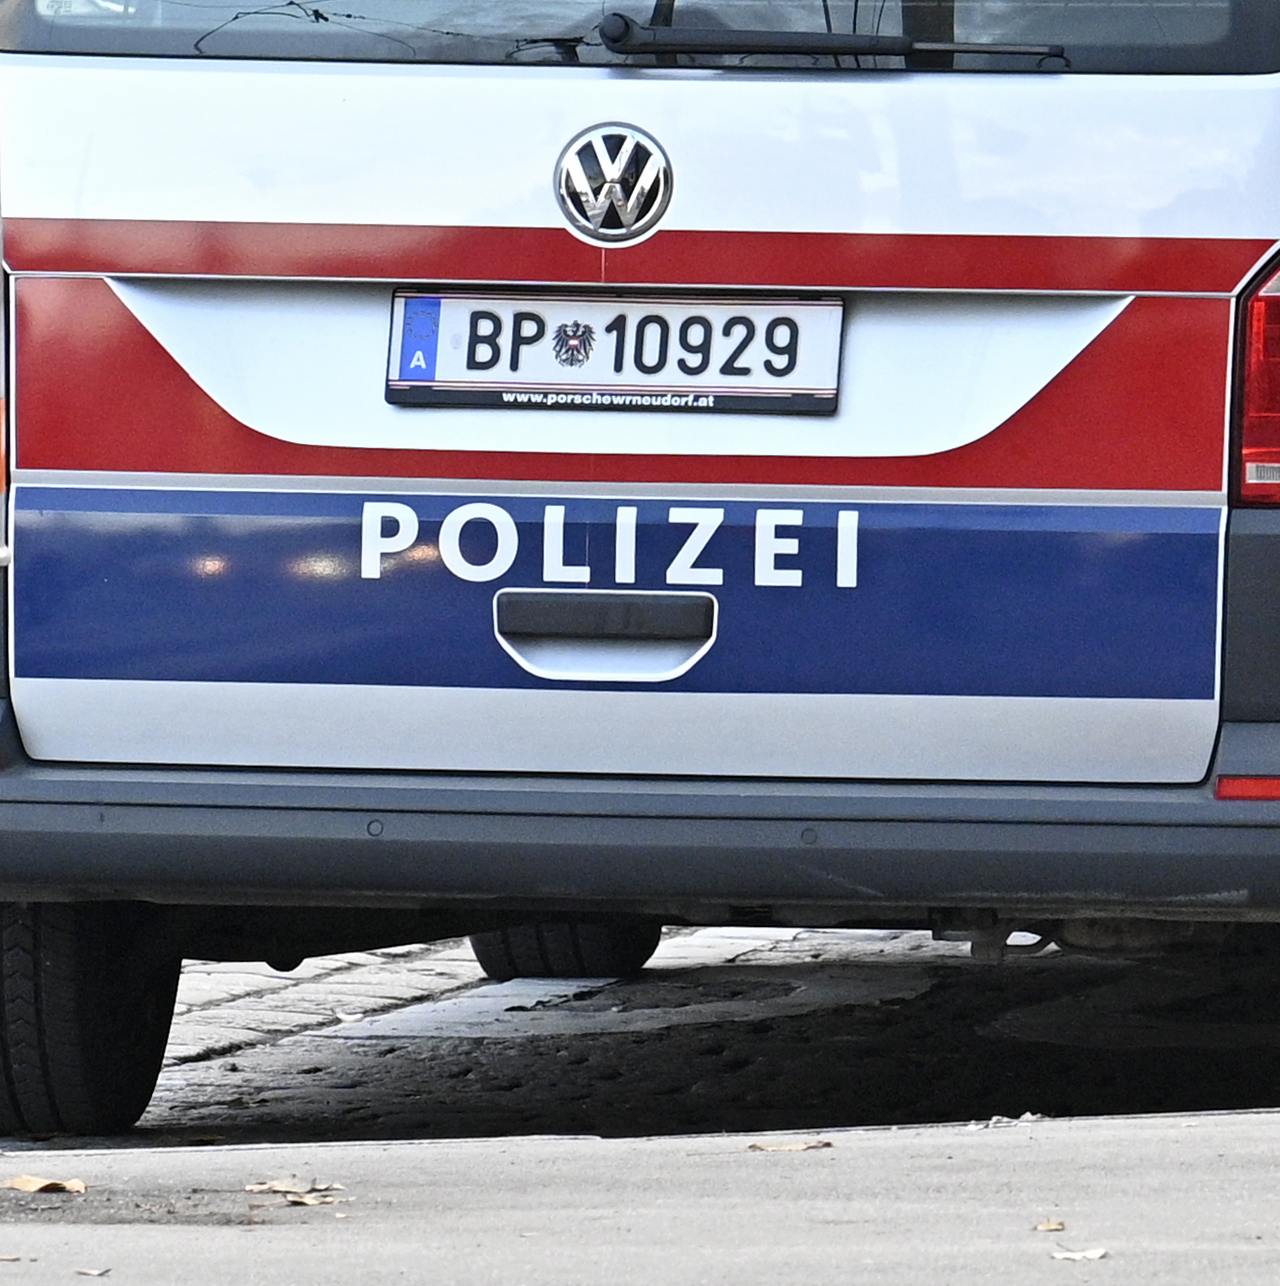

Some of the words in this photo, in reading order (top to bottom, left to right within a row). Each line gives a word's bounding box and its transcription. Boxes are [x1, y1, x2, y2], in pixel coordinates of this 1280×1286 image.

[409, 350, 427, 369] A
[466, 311, 545, 372] BP
[604, 315, 799, 377] 10929
[502, 391, 715, 408] www.porschewrneudorf.at
[361, 502, 859, 588] POLIZEI
